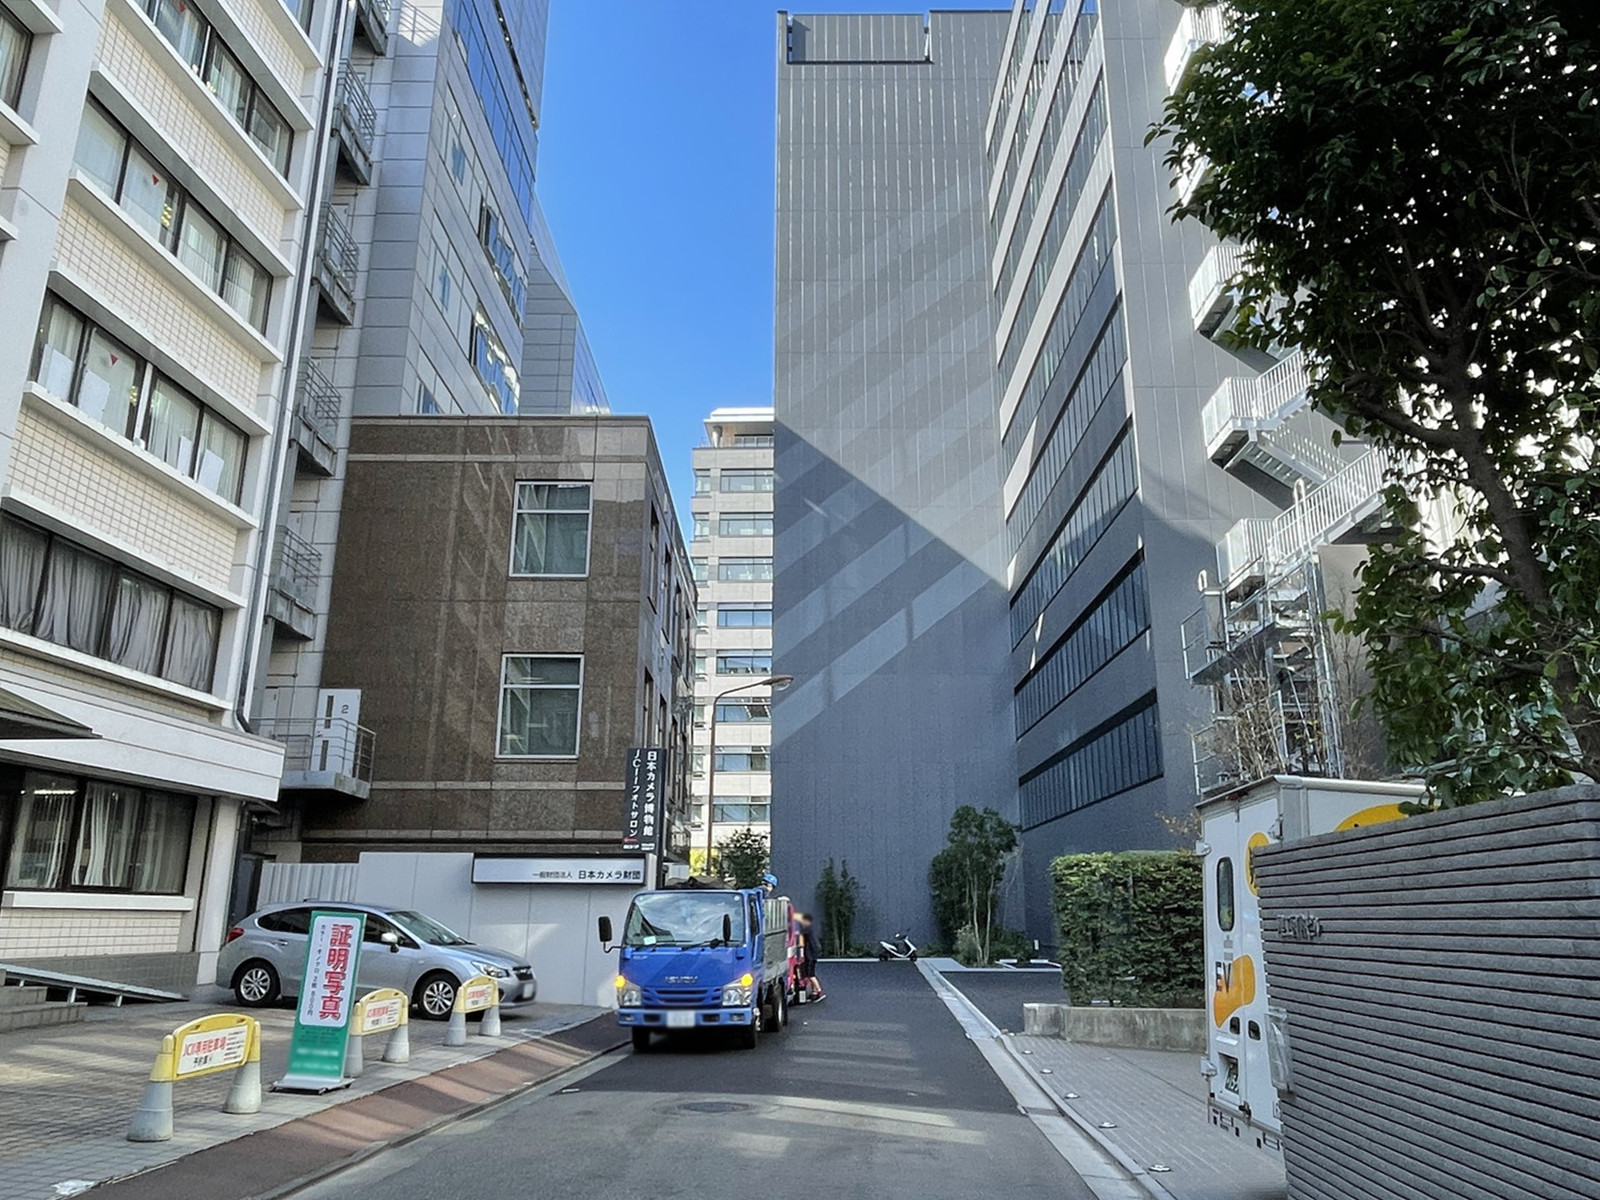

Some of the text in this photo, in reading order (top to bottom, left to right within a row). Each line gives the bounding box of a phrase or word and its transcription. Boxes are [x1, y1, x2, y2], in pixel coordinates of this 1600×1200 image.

[341, 704, 349, 714] 2
[643, 751, 657, 836] 日本カメラ博物館
[578, 870, 642, 880] 日本カメラ財団
[319, 924, 353, 1022] 証明写真
[1216, 961, 1231, 993] EV
